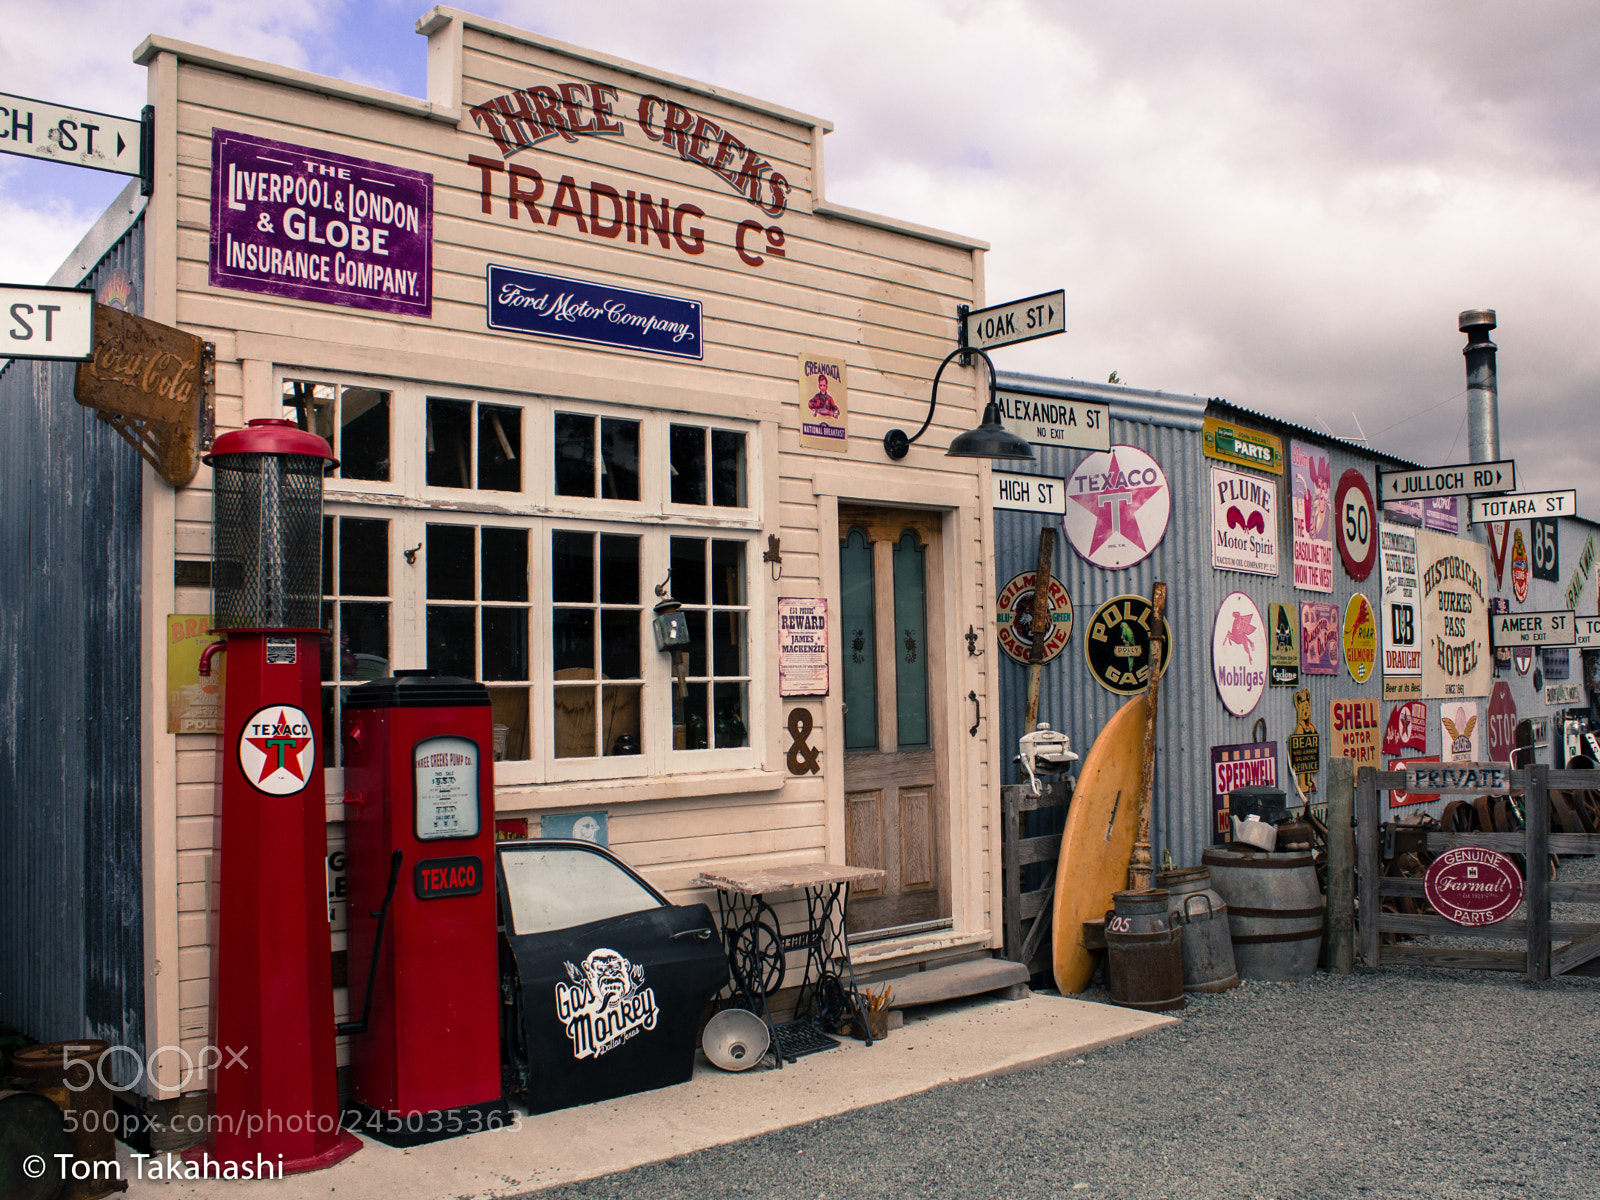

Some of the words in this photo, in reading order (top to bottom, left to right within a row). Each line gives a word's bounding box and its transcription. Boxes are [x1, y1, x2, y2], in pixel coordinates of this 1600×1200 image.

[58, 119, 100, 155] ST
[469, 83, 624, 159] THREE
[637, 94, 792, 218] CREEKS
[302, 160, 352, 181] THE
[228, 163, 333, 211] LIVERPOOL
[334, 190, 346, 213] &
[348, 183, 419, 234] LONDON
[467, 153, 706, 255] TRADING
[256, 212, 275, 233] &
[282, 207, 389, 256] GLOBE
[226, 233, 330, 282] INSURANCE
[9, 303, 61, 342] ST
[498, 283, 548, 311] Ford
[539, 293, 604, 322] Motor
[603, 299, 695, 342] Company
[985, 312, 1016, 339] OAK
[1027, 305, 1045, 329] ST
[999, 397, 1077, 427] ALEXANDRA
[1086, 410, 1101, 429] ST
[1037, 426, 1047, 438] NO
[1051, 429, 1065, 440] EXIT
[1234, 439, 1271, 461] PARTS
[999, 479, 1030, 502] HIGH
[1038, 483, 1053, 504] ST
[1075, 467, 1157, 493] TEXACO
[1401, 472, 1464, 494] JULLOCH
[1474, 470, 1493, 487] RD
[1217, 479, 1271, 513] PLUME
[1481, 499, 1536, 517] TOTARA
[1546, 497, 1565, 512] ST
[1294, 517, 1304, 538] THE
[1346, 503, 1369, 545] 50
[1217, 530, 1248, 551] Motor
[1250, 535, 1274, 558] Spirit
[1294, 541, 1320, 564] GASOLINE
[1320, 545, 1332, 566] THAT
[1535, 520, 1556, 571] 85
[1294, 563, 1308, 585] WON
[1308, 566, 1319, 586] THE
[1319, 568, 1332, 588] WEST
[1424, 555, 1485, 603] HISTORICAL
[999, 575, 1068, 609] GILMRE
[1438, 590, 1473, 614] BURKES
[781, 615, 825, 630] REWARD
[1052, 612, 1071, 622] GREEN
[1092, 601, 1165, 642] POLL
[1391, 603, 1414, 646] DB
[1444, 616, 1466, 638] PASS
[1501, 617, 1542, 632] AMEER
[1551, 615, 1566, 630] ST
[172, 618, 215, 645] BRA
[791, 635, 814, 645] JAMES
[1358, 628, 1375, 640] ROAR
[1520, 634, 1529, 642] NO
[1533, 633, 1546, 641] EXIT
[1578, 636, 1591, 644] EXIT
[782, 645, 825, 653] MACKENZIE
[999, 628, 1067, 661] GASOINE
[1346, 648, 1374, 662] GILMORE
[1436, 634, 1478, 677] HOTEL
[1386, 650, 1421, 669] DRAUGHT
[1104, 664, 1149, 685] GAS
[1218, 665, 1264, 692] Mobilgas
[1385, 683, 1397, 693] Beer
[1397, 683, 1404, 692] at
[1333, 702, 1378, 730] SHELL
[251, 723, 308, 736] TEXACO
[786, 707, 820, 776] &
[1342, 730, 1372, 745] MOTOR
[1490, 714, 1517, 749] STOP
[266, 739, 297, 769] T
[1292, 736, 1319, 749] BEAR
[430, 752, 448, 767] CREEKS
[449, 752, 464, 767] PUMP
[1293, 761, 1318, 771] SERVICE
[1218, 758, 1275, 792] SPEEDWELL
[1414, 768, 1503, 789] PRIVATE
[1443, 850, 1503, 867] GENUINE
[421, 865, 476, 890] TEXACO
[1437, 875, 1507, 893] Farmall
[1453, 909, 1495, 923] PARTS
[555, 979, 597, 1022] Gas
[566, 987, 660, 1060] Monkey
